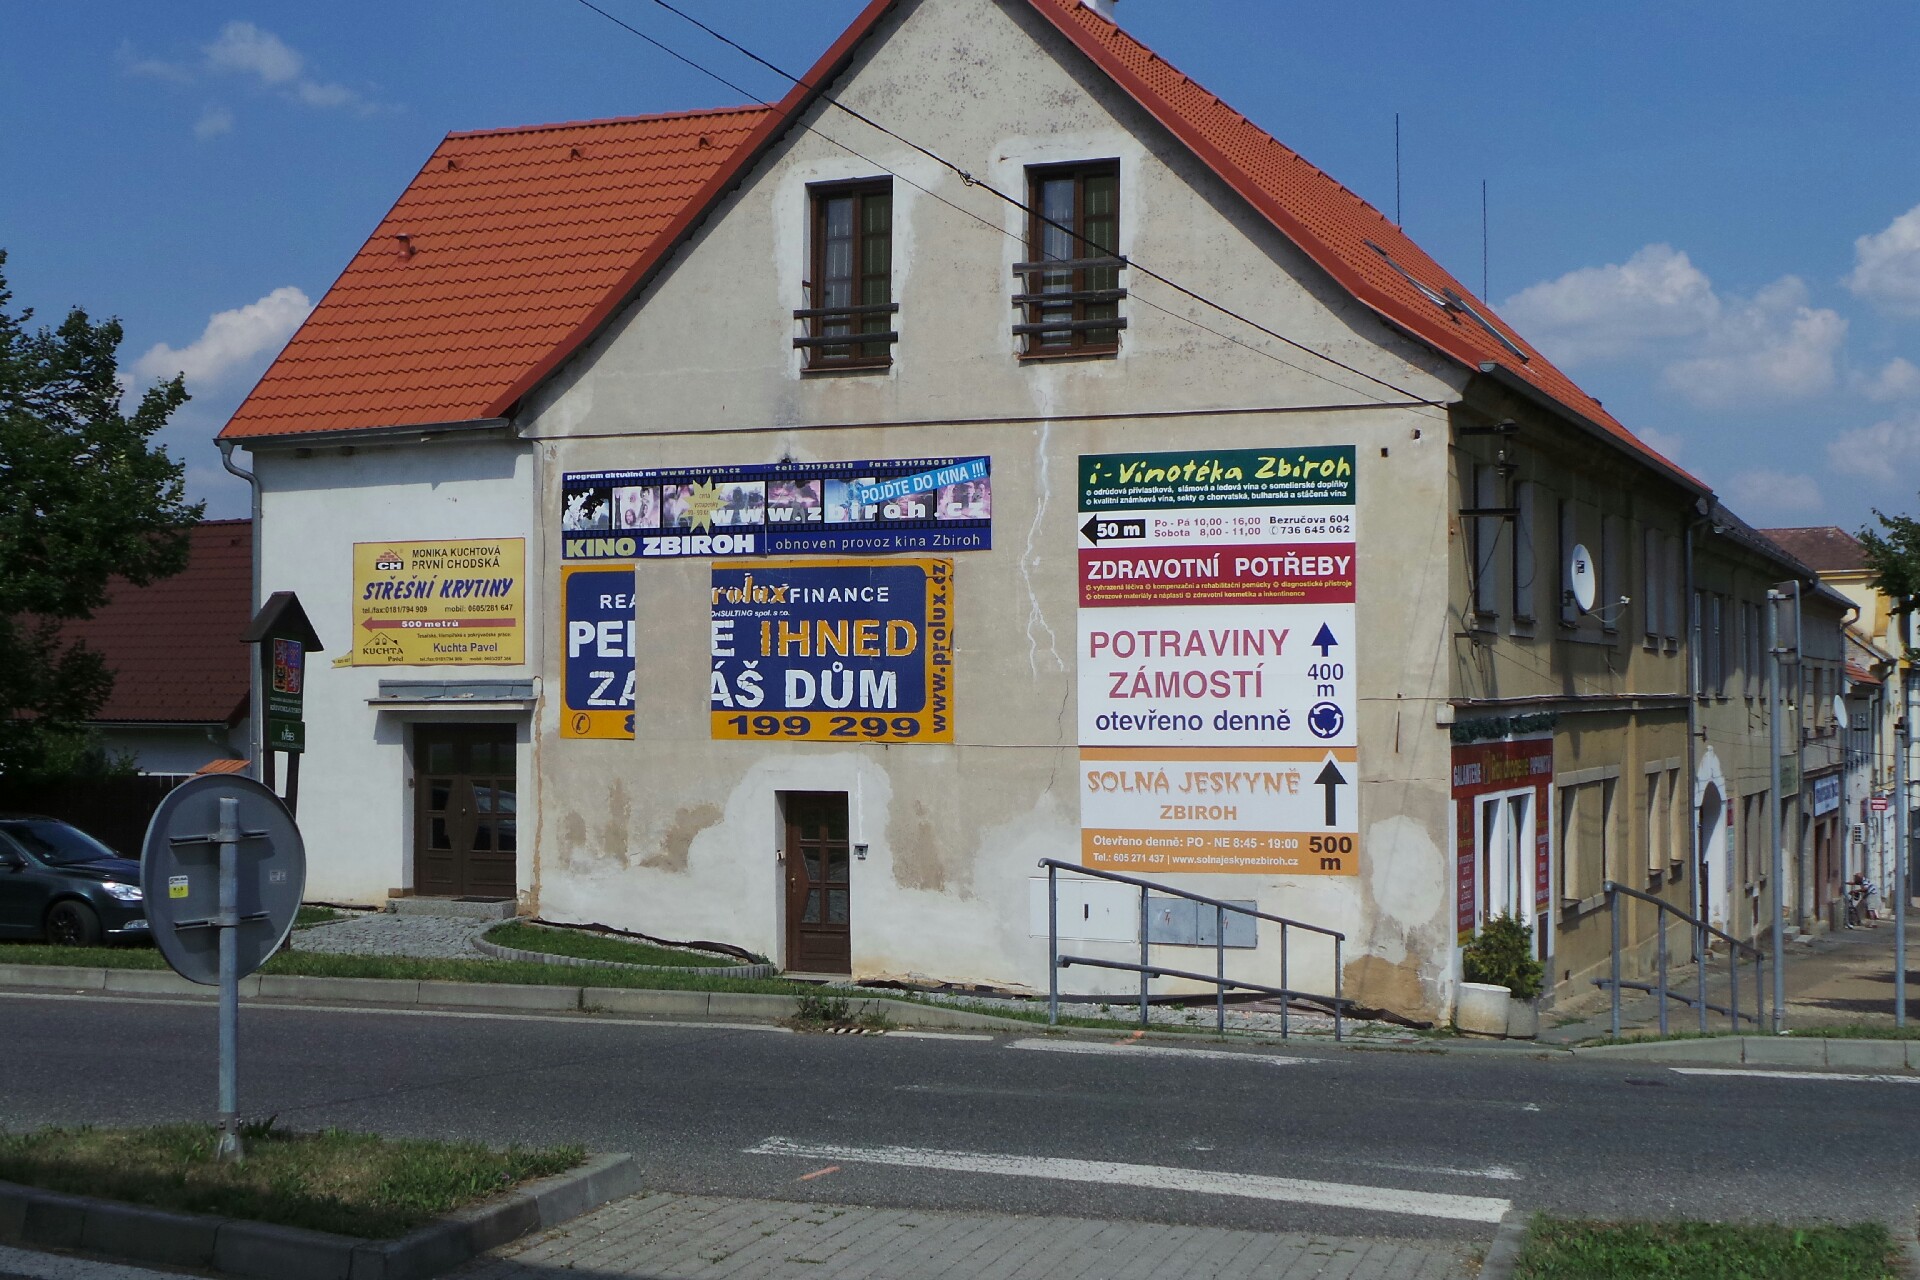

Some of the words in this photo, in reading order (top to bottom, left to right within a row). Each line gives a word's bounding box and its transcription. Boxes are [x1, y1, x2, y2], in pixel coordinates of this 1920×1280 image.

[1255, 456, 1350, 479] Zbiroh
[861, 479, 910, 503] POJĎTE
[914, 475, 932, 491] DO
[937, 466, 969, 486] KINA
[1317, 480, 1348, 490] doplňky
[1177, 493, 1197, 502] sekty
[1251, 490, 1288, 499] bulharská
[1297, 489, 1328, 498] stáčená
[1330, 489, 1347, 497] vína
[710, 500, 990, 524] www.zbiroh.cz
[1270, 515, 1325, 524] Bezručova
[1330, 514, 1349, 523] 604
[1097, 524, 1120, 537] 50
[1124, 524, 1140, 536] m
[1154, 519, 1167, 527] Po
[1177, 518, 1190, 527] Pá
[1194, 517, 1222, 528] 10,00
[1232, 517, 1260, 527] 16,00
[1281, 526, 1301, 534] 736
[1305, 525, 1324, 534] 645
[1329, 525, 1350, 533] 062
[1154, 528, 1190, 538] Sobota
[1200, 528, 1222, 538] 8,00
[1232, 527, 1260, 537] 11,00
[566, 537, 636, 557] KINO
[643, 534, 754, 555] ZBIROH
[776, 538, 835, 549] obnoven
[842, 537, 889, 550] provoz
[895, 536, 926, 547] kina
[933, 534, 980, 546] Zbiroh
[413, 548, 448, 557] MONIKA
[451, 545, 501, 556] KUCHTOVÁ
[412, 559, 443, 569] PRVNÍ
[447, 558, 500, 568] CHODSKÁ
[1088, 552, 1220, 580] ZDRAVOTNÍ
[1236, 551, 1350, 576] POTŘEBY
[363, 575, 437, 600] STŘEŠNÍ
[440, 578, 513, 598] KRYTINY
[790, 586, 888, 604] FINANCE
[760, 620, 917, 657] IHNED
[1091, 629, 1289, 658] POTRAVINY
[433, 643, 467, 652] Kuchta
[470, 642, 497, 652] Pavel
[928, 565, 951, 733] www.prolux.cz
[1308, 664, 1344, 680] 400
[785, 661, 897, 708] DŮM
[1109, 663, 1264, 698] ZÁMOSTÍ
[1318, 684, 1334, 697] m
[728, 715, 810, 736] 199
[829, 717, 920, 736] 299
[1096, 709, 1203, 731] otevřeno
[1213, 709, 1291, 730] denně
[1088, 767, 1170, 796] SOLNÁ
[1178, 768, 1301, 796] JESKYNĚ
[1160, 805, 1237, 820] ZBIROH
[1093, 835, 1142, 847] Otevřeno
[1146, 836, 1183, 848] denně:
[1187, 838, 1203, 848] PO
[1214, 838, 1230, 848] NE
[1233, 838, 1257, 848] 8:45
[1268, 838, 1298, 849] 19:00
[1309, 836, 1352, 853] 500
[1093, 852, 1110, 862] Tel.:
[1114, 853, 1128, 862] 605
[1130, 853, 1146, 863] 271
[1149, 854, 1164, 863] 437
[1172, 855, 1298, 867] www.solnajeskynezbiroh.cz
[1321, 858, 1341, 870] m
